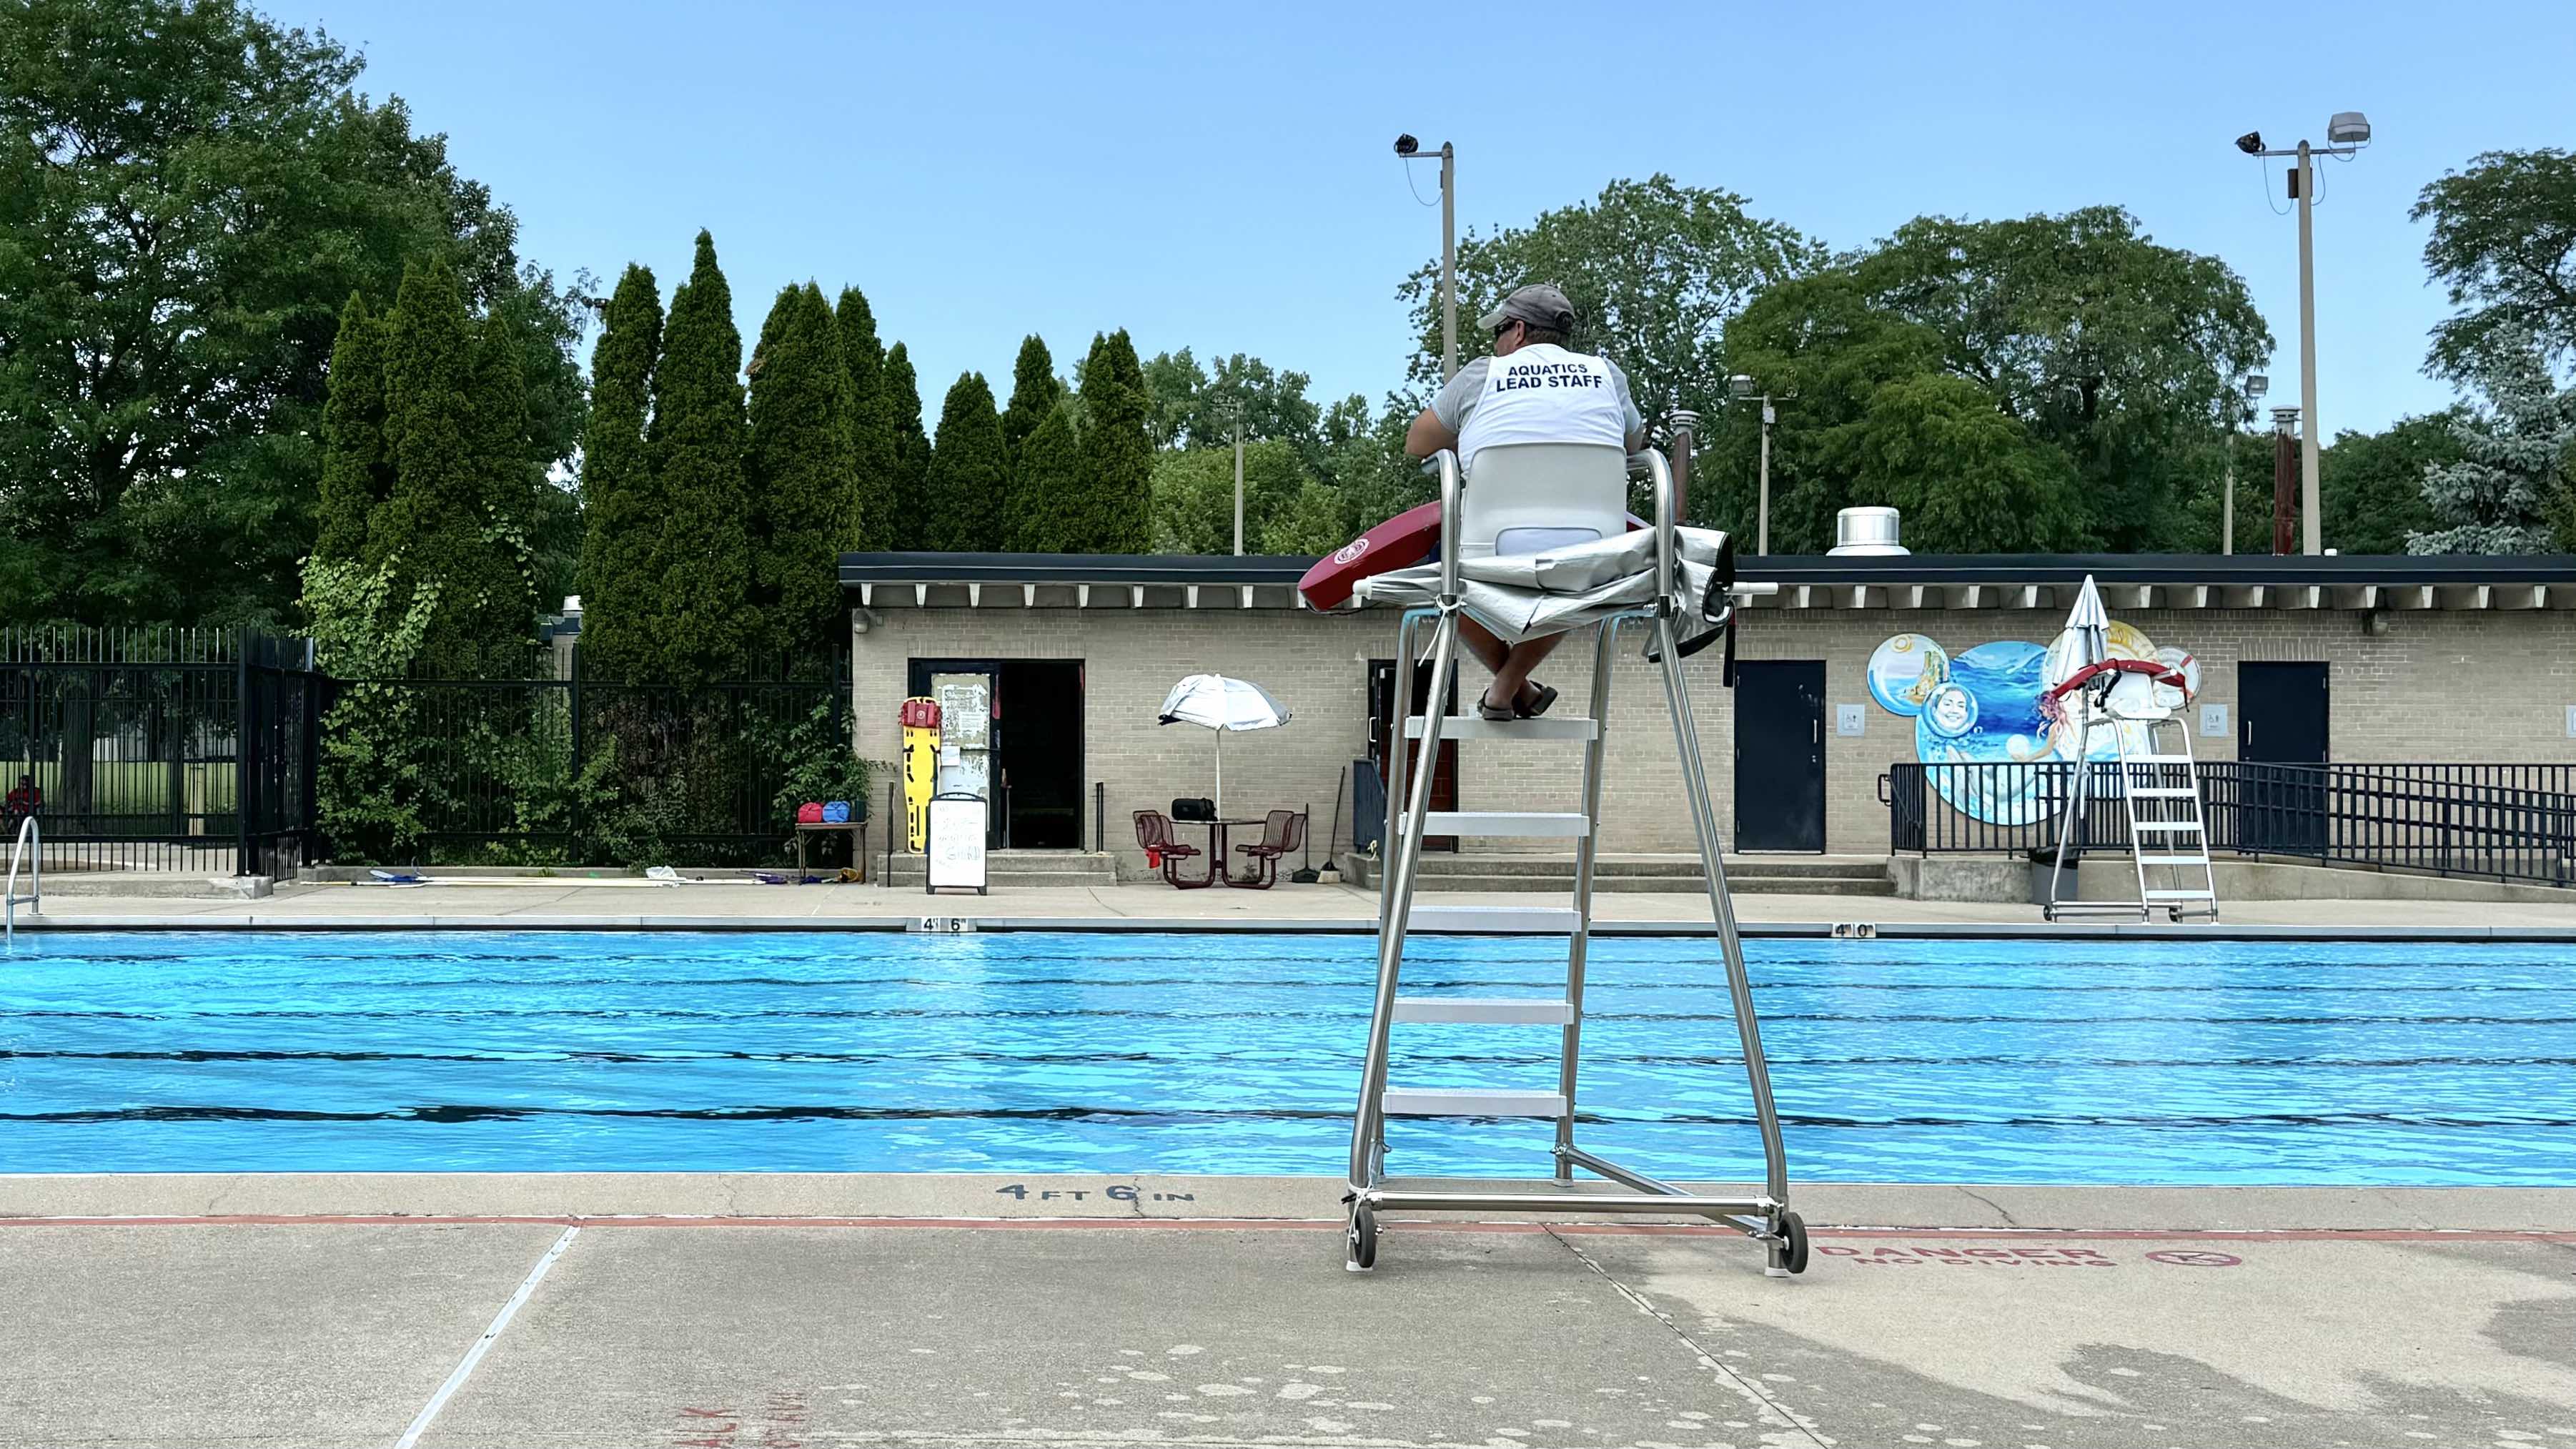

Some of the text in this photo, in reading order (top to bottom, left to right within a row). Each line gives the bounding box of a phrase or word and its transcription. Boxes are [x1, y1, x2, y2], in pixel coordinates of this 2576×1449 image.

[1508, 364, 1587, 376] AQUATICS
[1497, 375, 1602, 392] LEAD STAFF
[996, 1185, 1029, 1200] 4
[1041, 1191, 1091, 1201] FT
[1106, 1185, 1137, 1200] 6
[1815, 1246, 2108, 1259] DANGER
